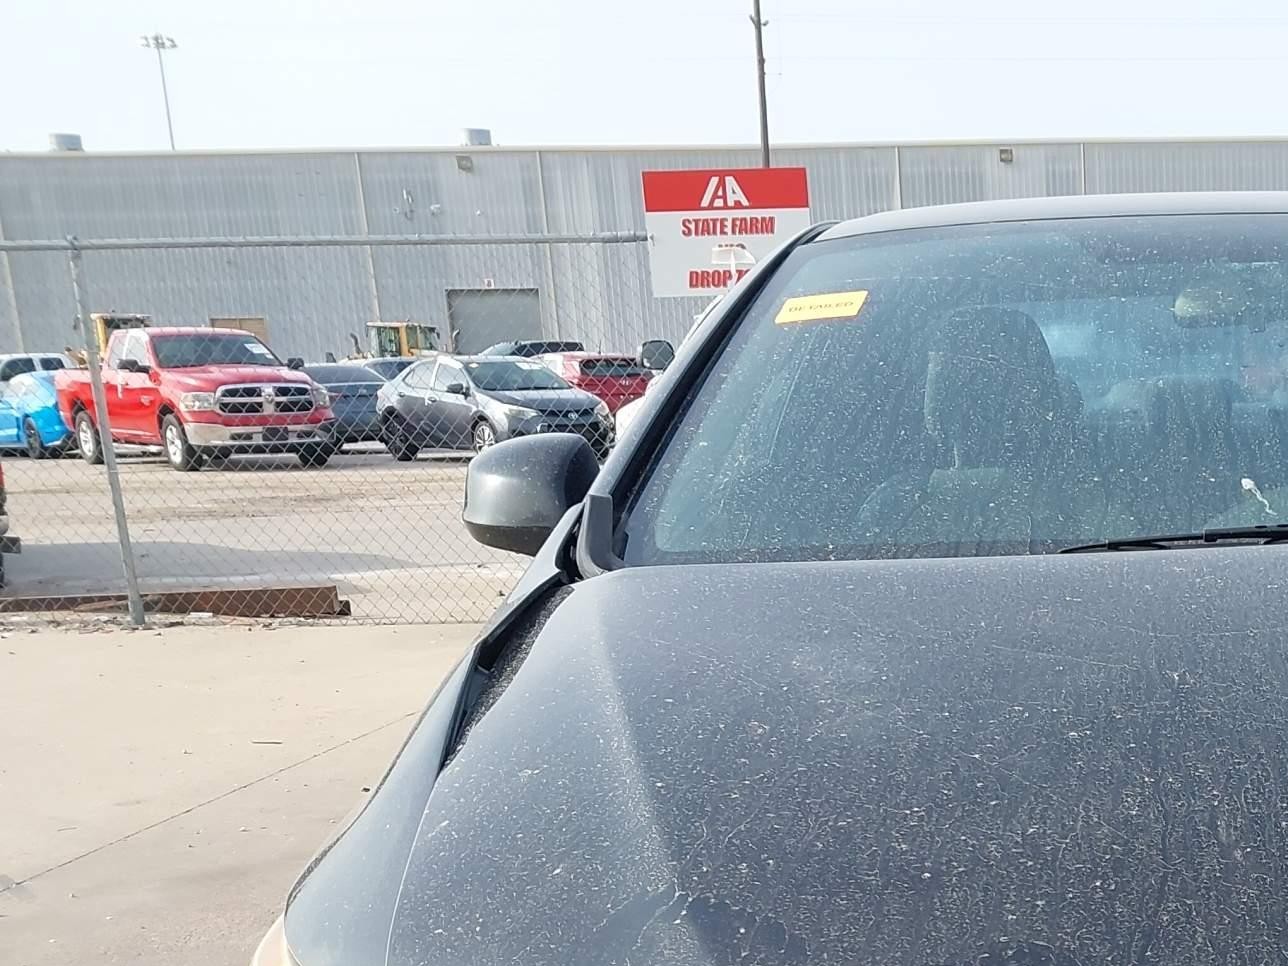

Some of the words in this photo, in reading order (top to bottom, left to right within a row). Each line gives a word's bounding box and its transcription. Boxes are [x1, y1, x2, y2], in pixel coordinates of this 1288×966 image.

[681, 217, 729, 237] STATE
[731, 215, 776, 236] FARM
[688, 269, 733, 289] DROP
